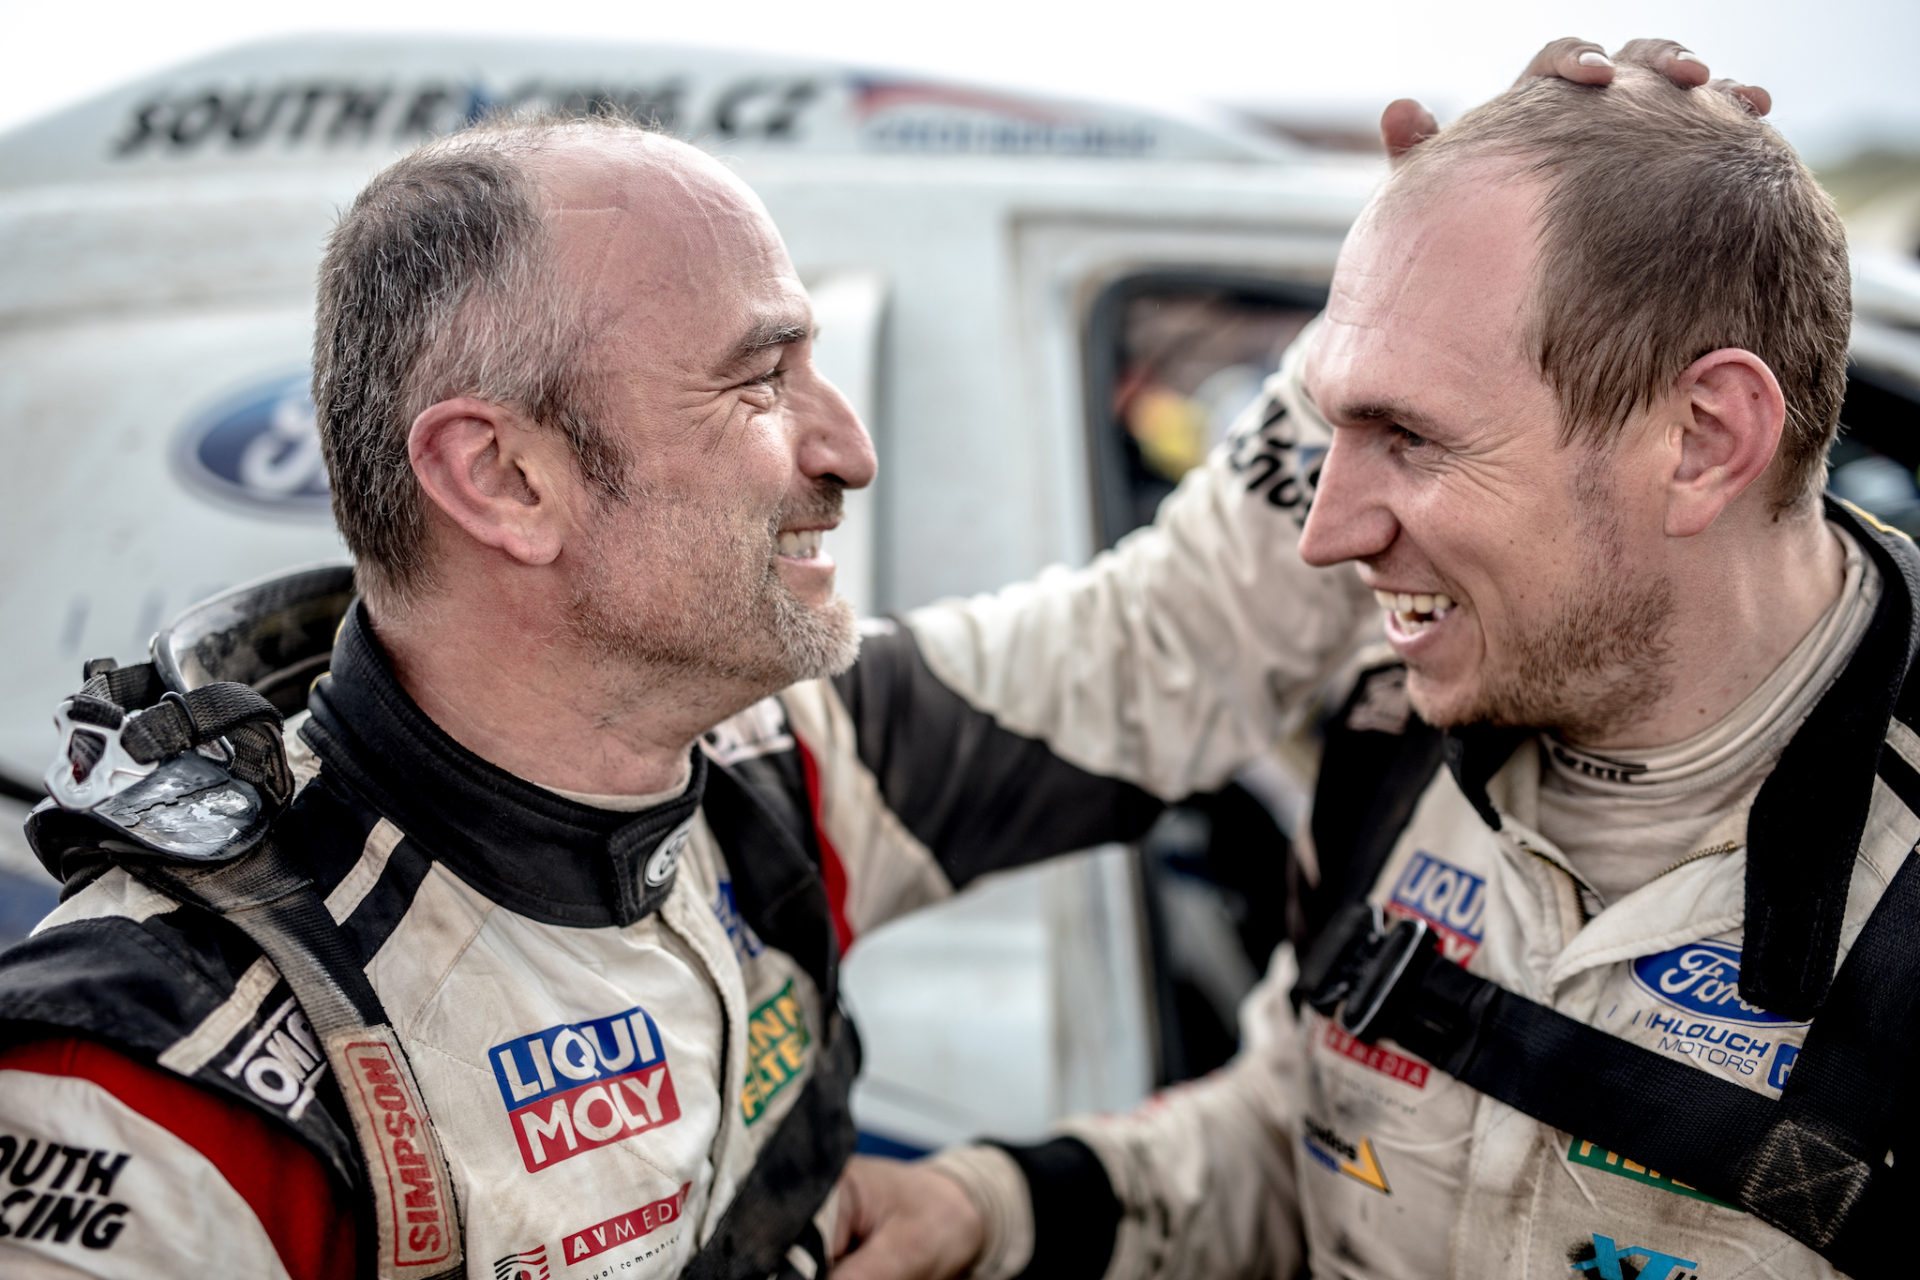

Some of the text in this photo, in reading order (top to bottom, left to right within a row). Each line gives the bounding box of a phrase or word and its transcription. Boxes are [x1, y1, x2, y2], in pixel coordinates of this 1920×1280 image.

[498, 1011, 657, 1103] LIQUI
[1650, 1013, 1771, 1058] HLOUCH
[1657, 1036, 1759, 1076] MOTORS
[359, 1057, 441, 1252] SIMPSON
[519, 1066, 667, 1165] MOLY
[572, 1194, 683, 1260] AVMEDI
